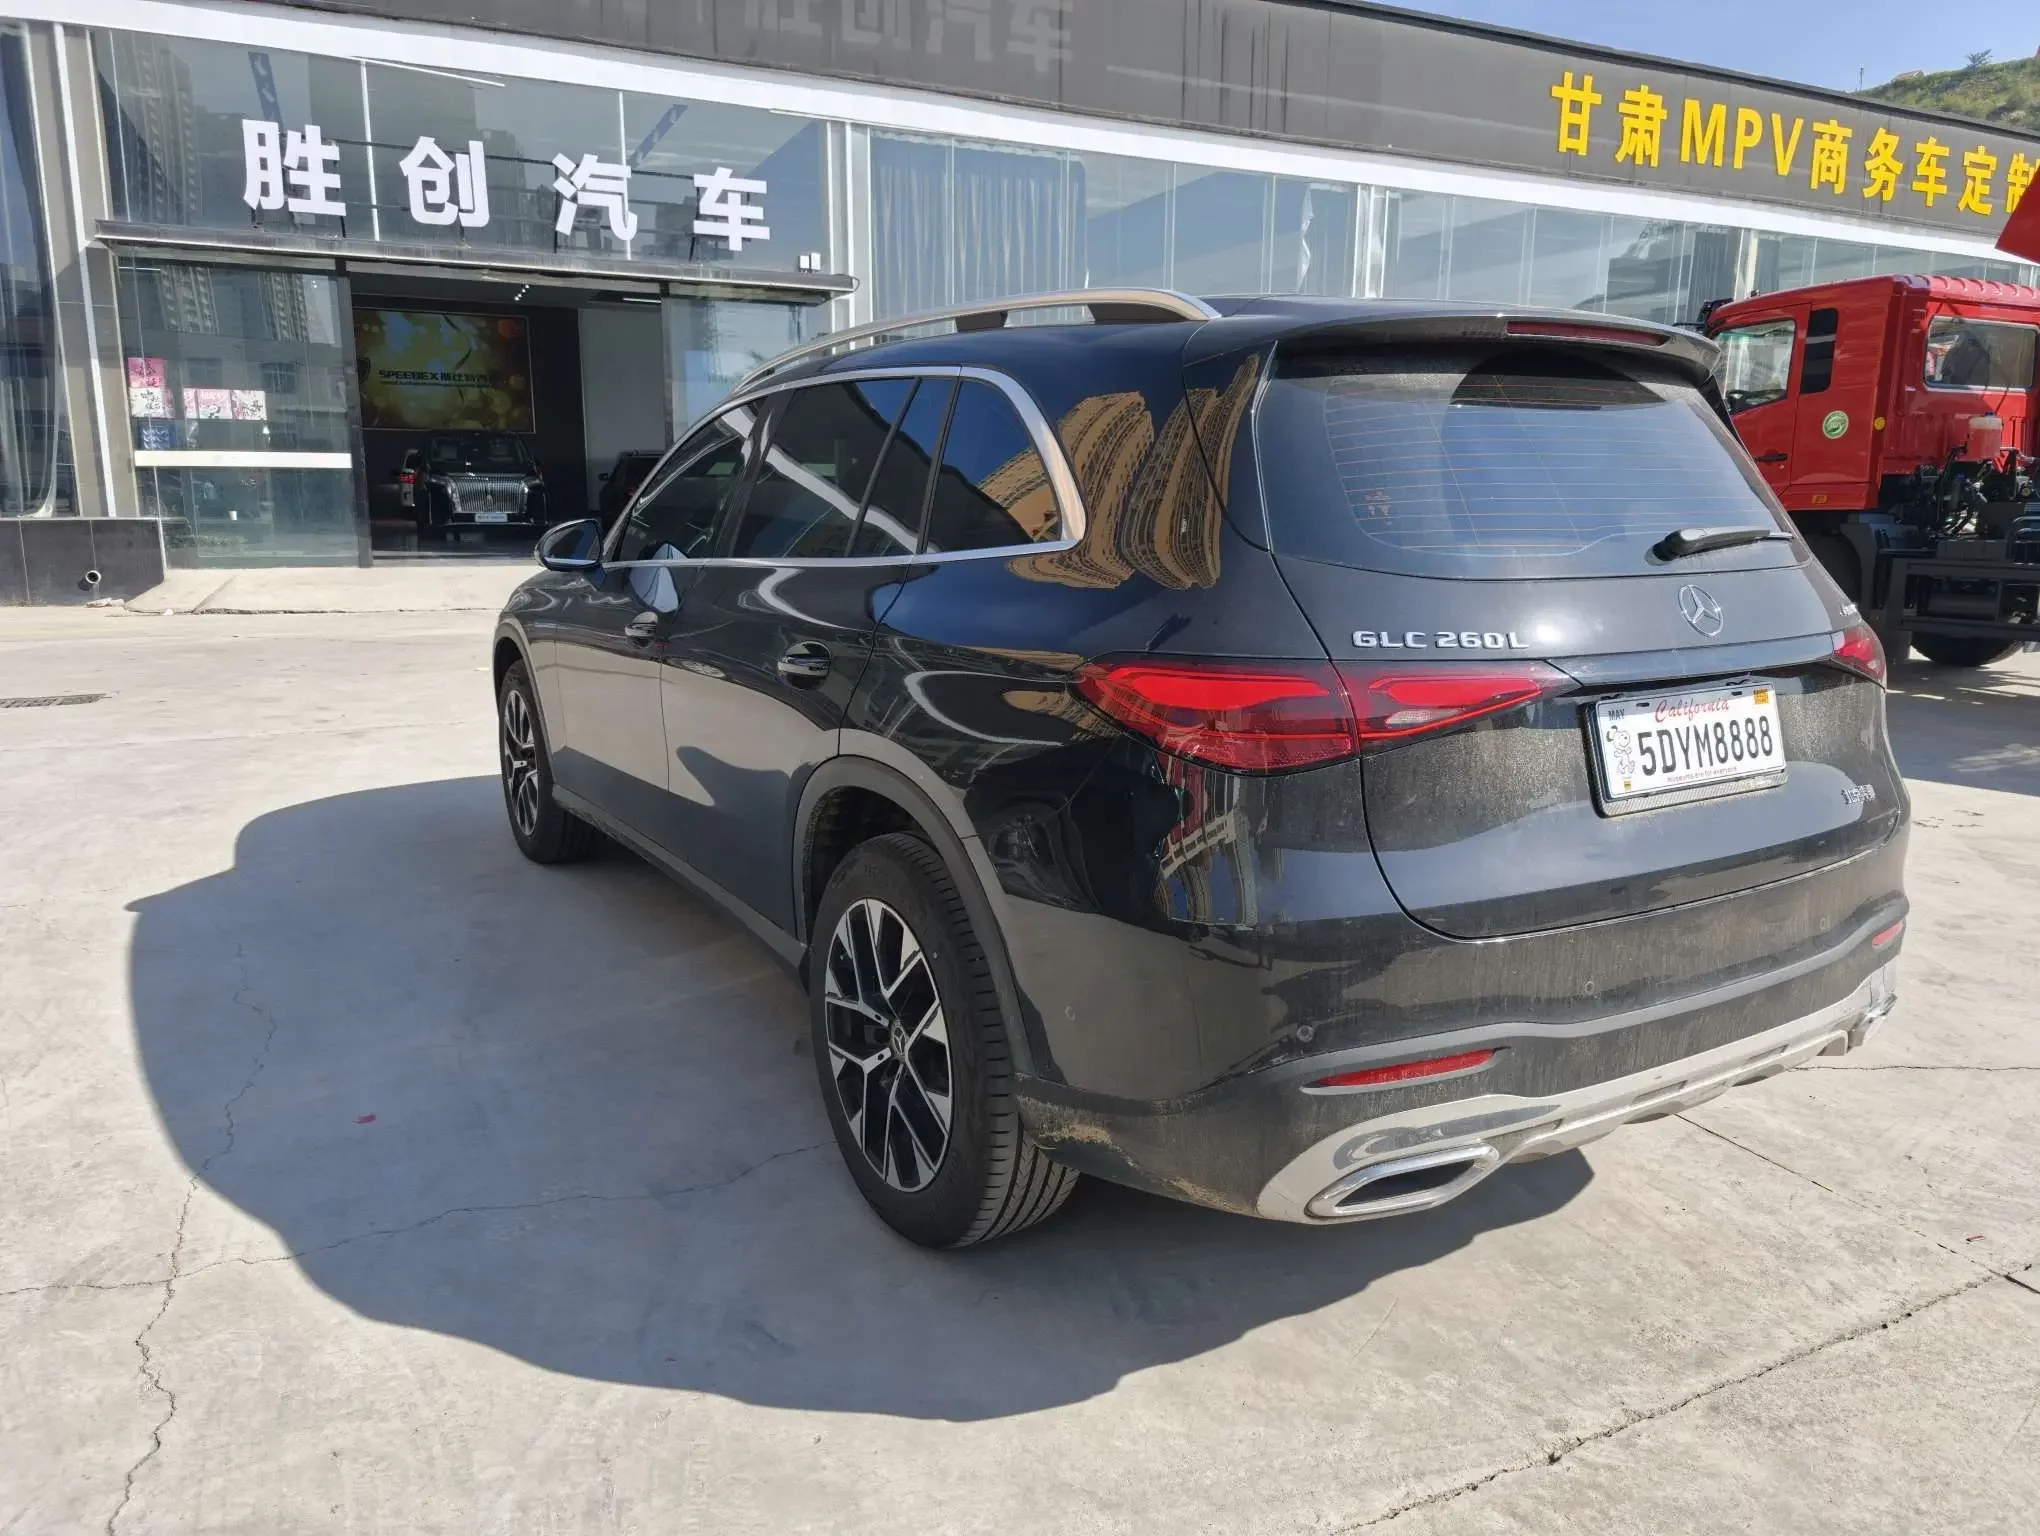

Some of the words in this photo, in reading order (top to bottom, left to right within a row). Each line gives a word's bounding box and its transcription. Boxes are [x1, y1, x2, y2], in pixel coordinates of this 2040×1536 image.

[241, 118, 771, 252] 胜创汽车
[1352, 630, 1428, 648] GLC
[1435, 631, 1530, 649] 260L
[1608, 708, 1625, 721] MAY
[1654, 697, 1730, 723] California
[1637, 715, 1773, 776] 5DYM8888
